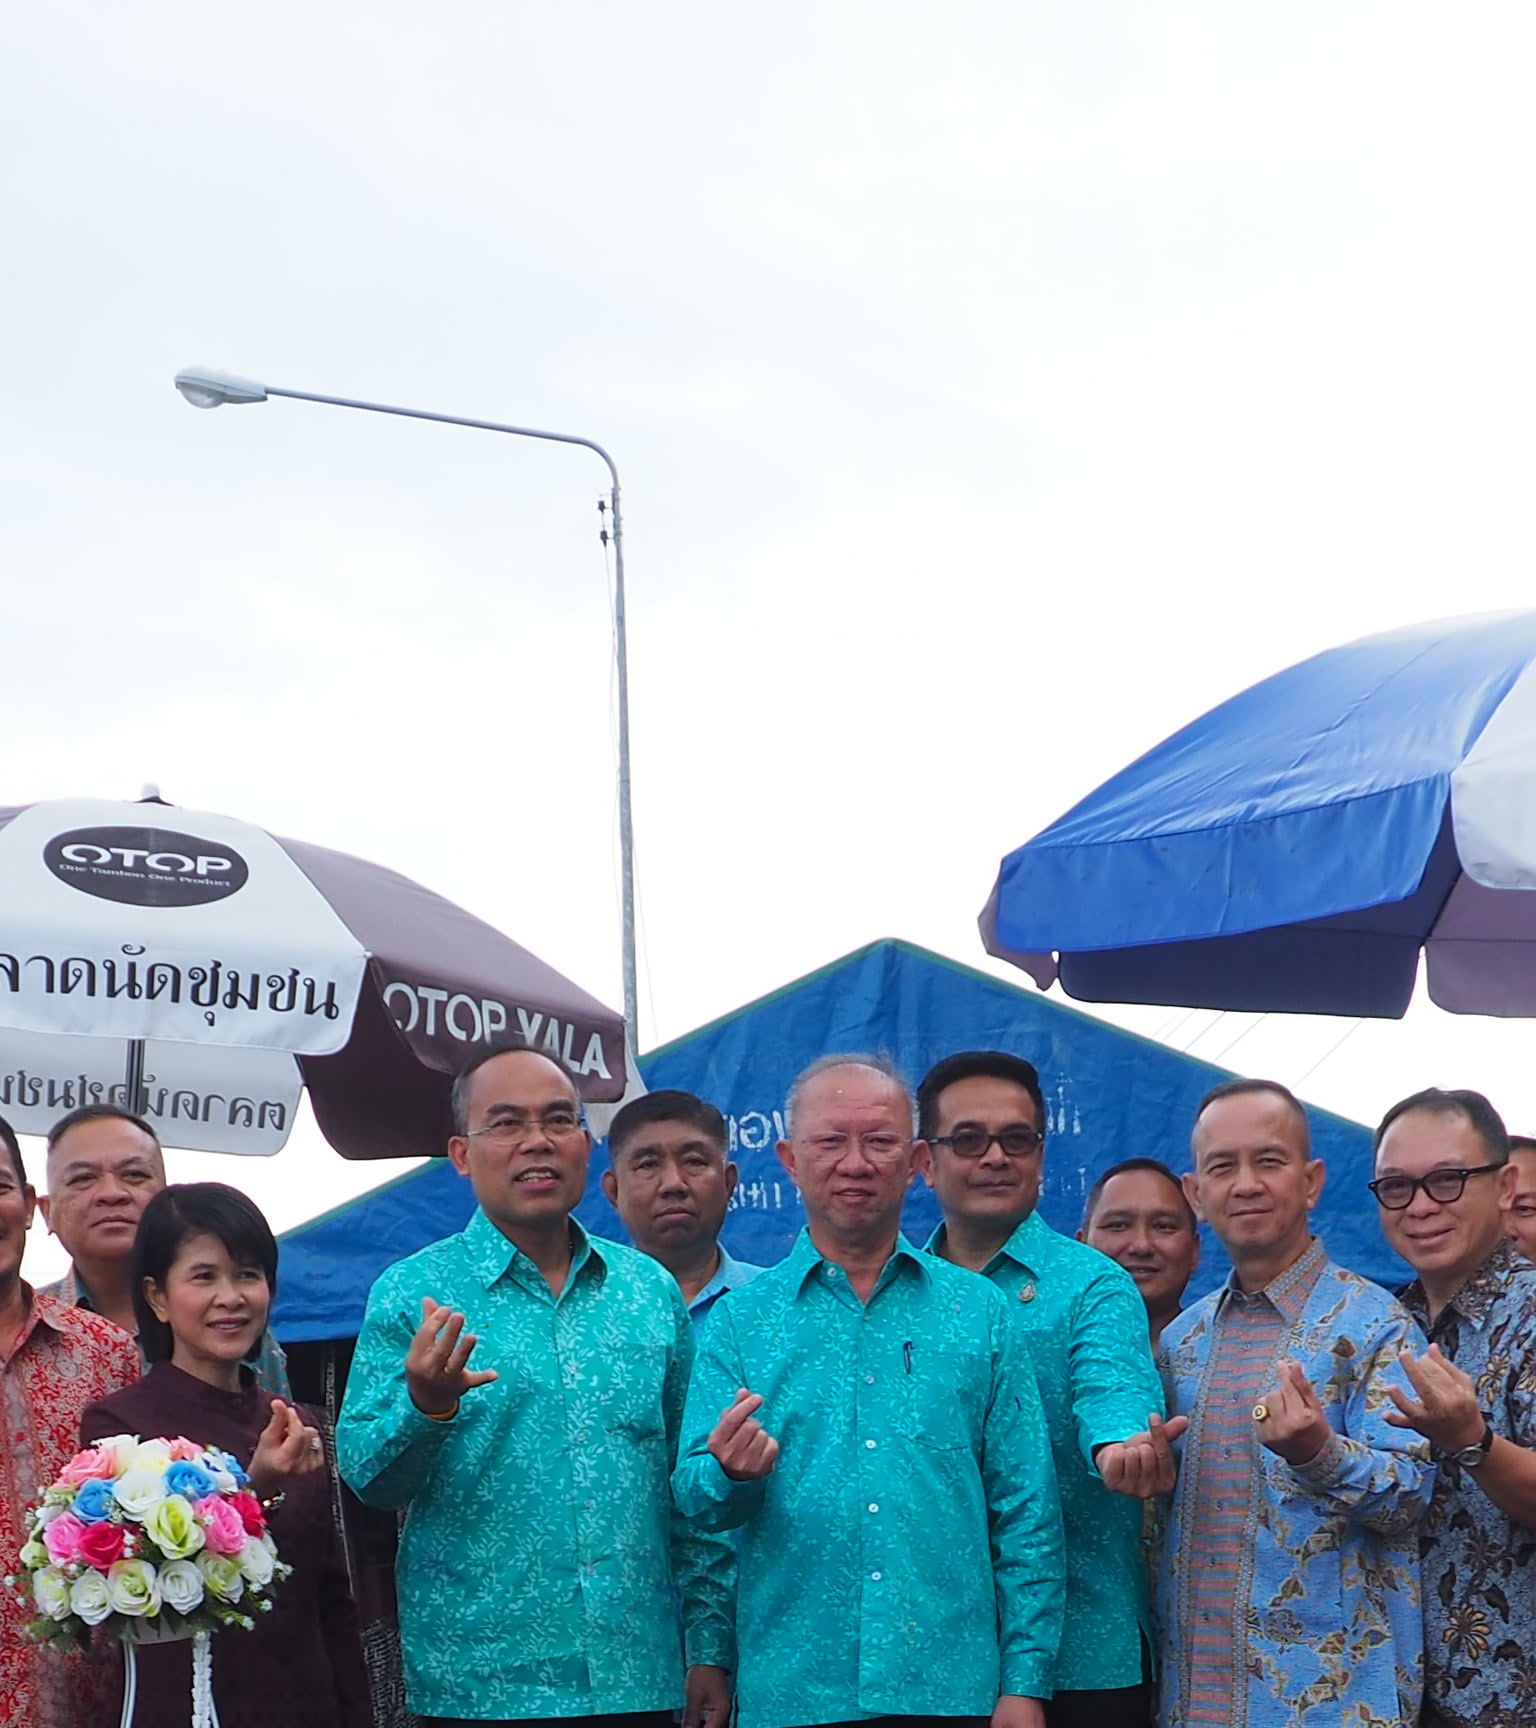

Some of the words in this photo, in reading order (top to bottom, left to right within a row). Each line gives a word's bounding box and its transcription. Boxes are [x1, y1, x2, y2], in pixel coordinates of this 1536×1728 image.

[60, 843, 233, 875] OTOP
[59, 864, 86, 872] One
[90, 867, 145, 880] Tambon
[148, 873, 176, 882] One
[179, 877, 231, 887] Product
[382, 981, 507, 1046] OTOP
[515, 1007, 613, 1081] YALA
